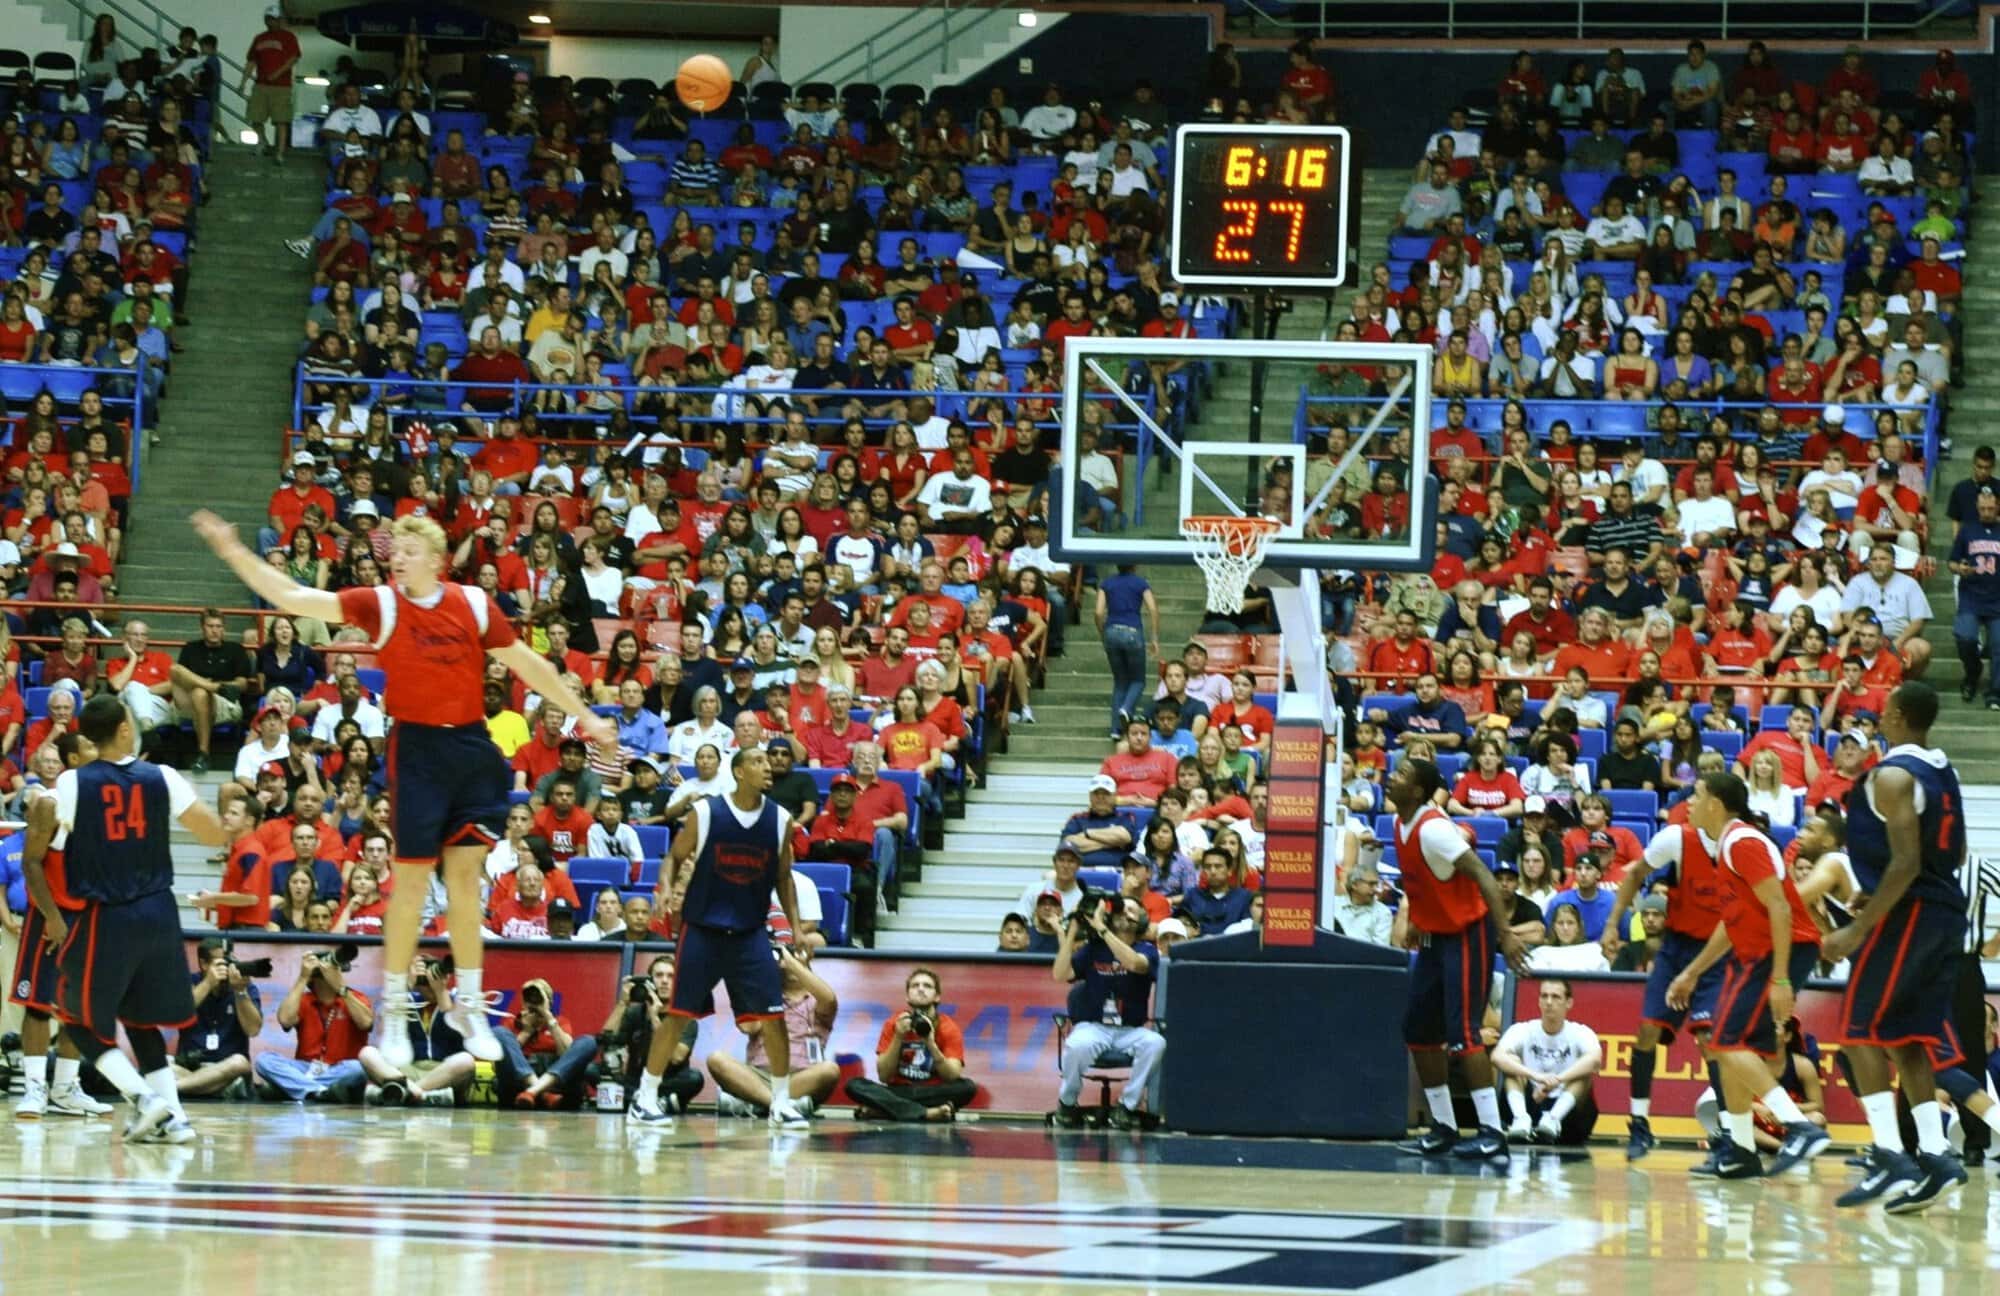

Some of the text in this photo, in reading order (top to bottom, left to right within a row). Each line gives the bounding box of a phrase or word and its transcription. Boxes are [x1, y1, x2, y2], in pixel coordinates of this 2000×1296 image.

[1225, 147, 1327, 188] 6:16
[1215, 201, 1303, 262] 27
[1275, 741, 1318, 752] WELLS
[1275, 752, 1317, 762] FARGO
[1271, 795, 1314, 805] WELLS
[102, 783, 148, 841] 24
[1271, 806, 1313, 817] FARGO
[1269, 851, 1312, 862] WELLS
[1269, 863, 1312, 873] FARGO
[1267, 908, 1311, 919] WELLS
[1268, 919, 1310, 930] FARGO
